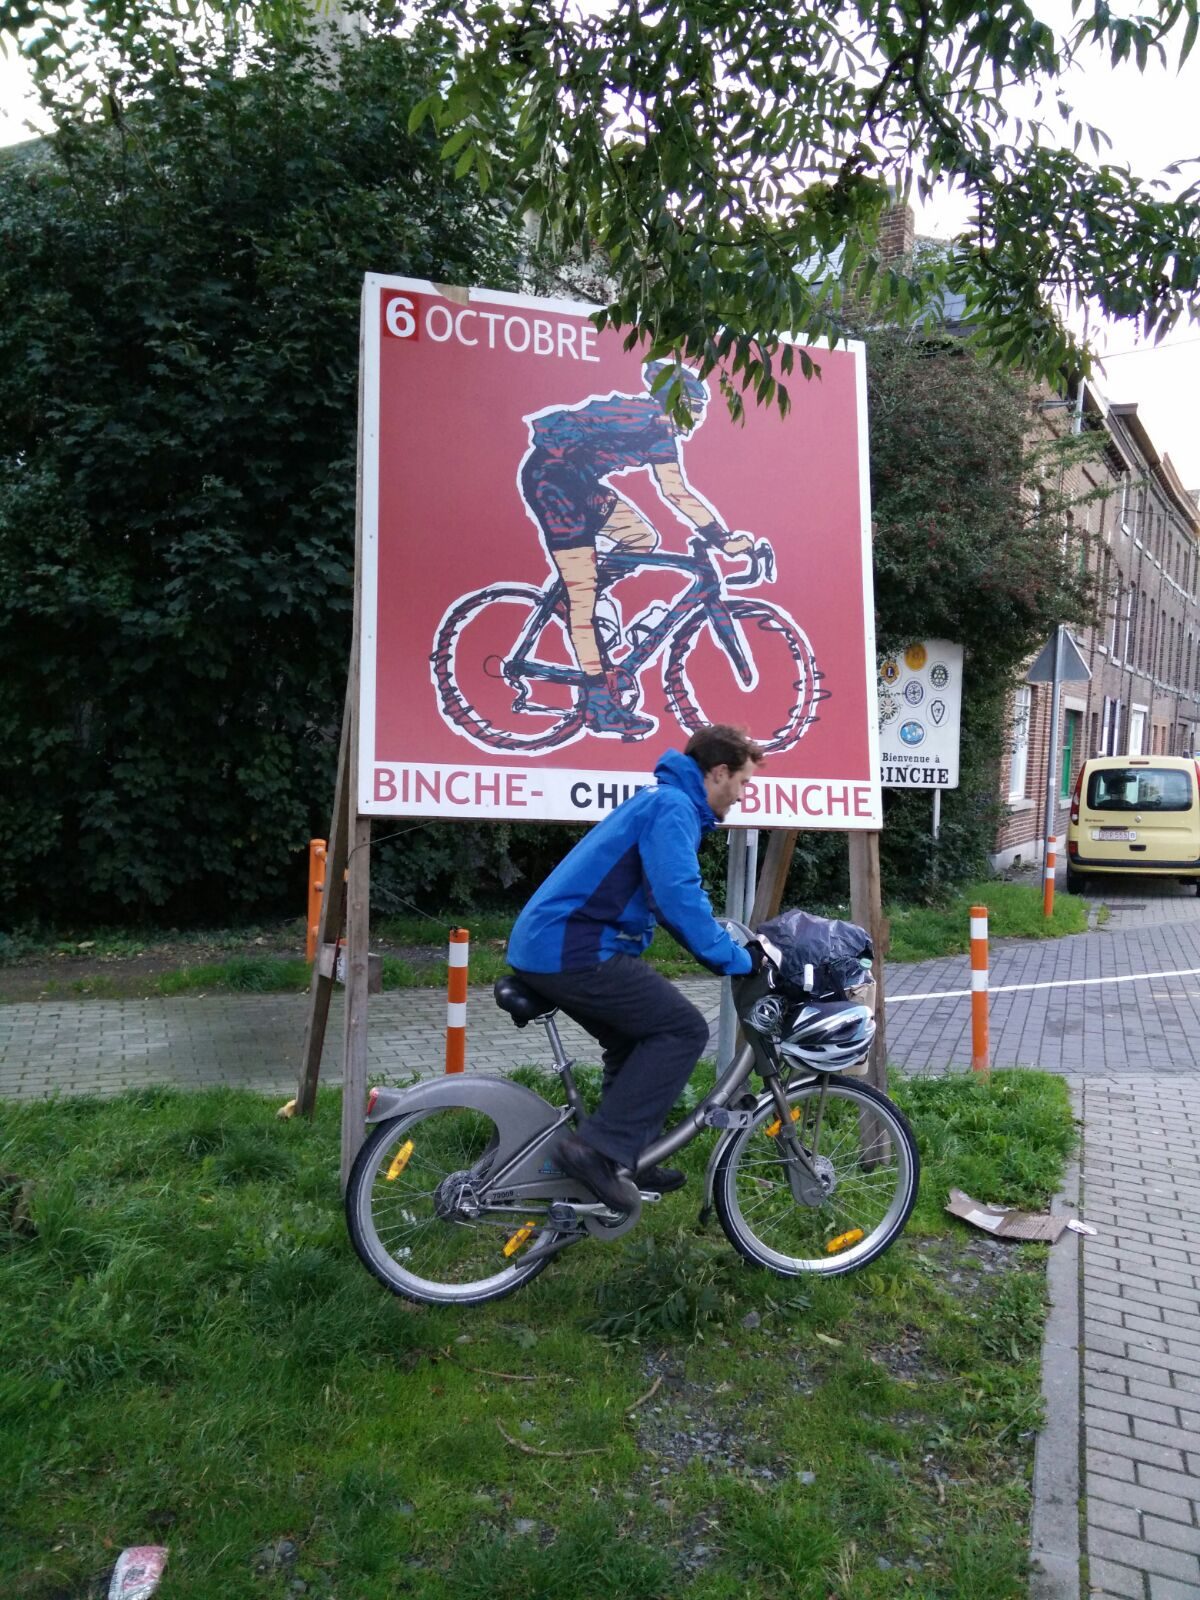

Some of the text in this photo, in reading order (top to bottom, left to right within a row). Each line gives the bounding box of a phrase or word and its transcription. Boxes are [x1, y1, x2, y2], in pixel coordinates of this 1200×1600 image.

[386, 298, 600, 362] 6 OCTOBRE
[882, 752, 940, 764] Bienvenue à
[374, 768, 873, 817] BINCHE- CHI BINCHE
